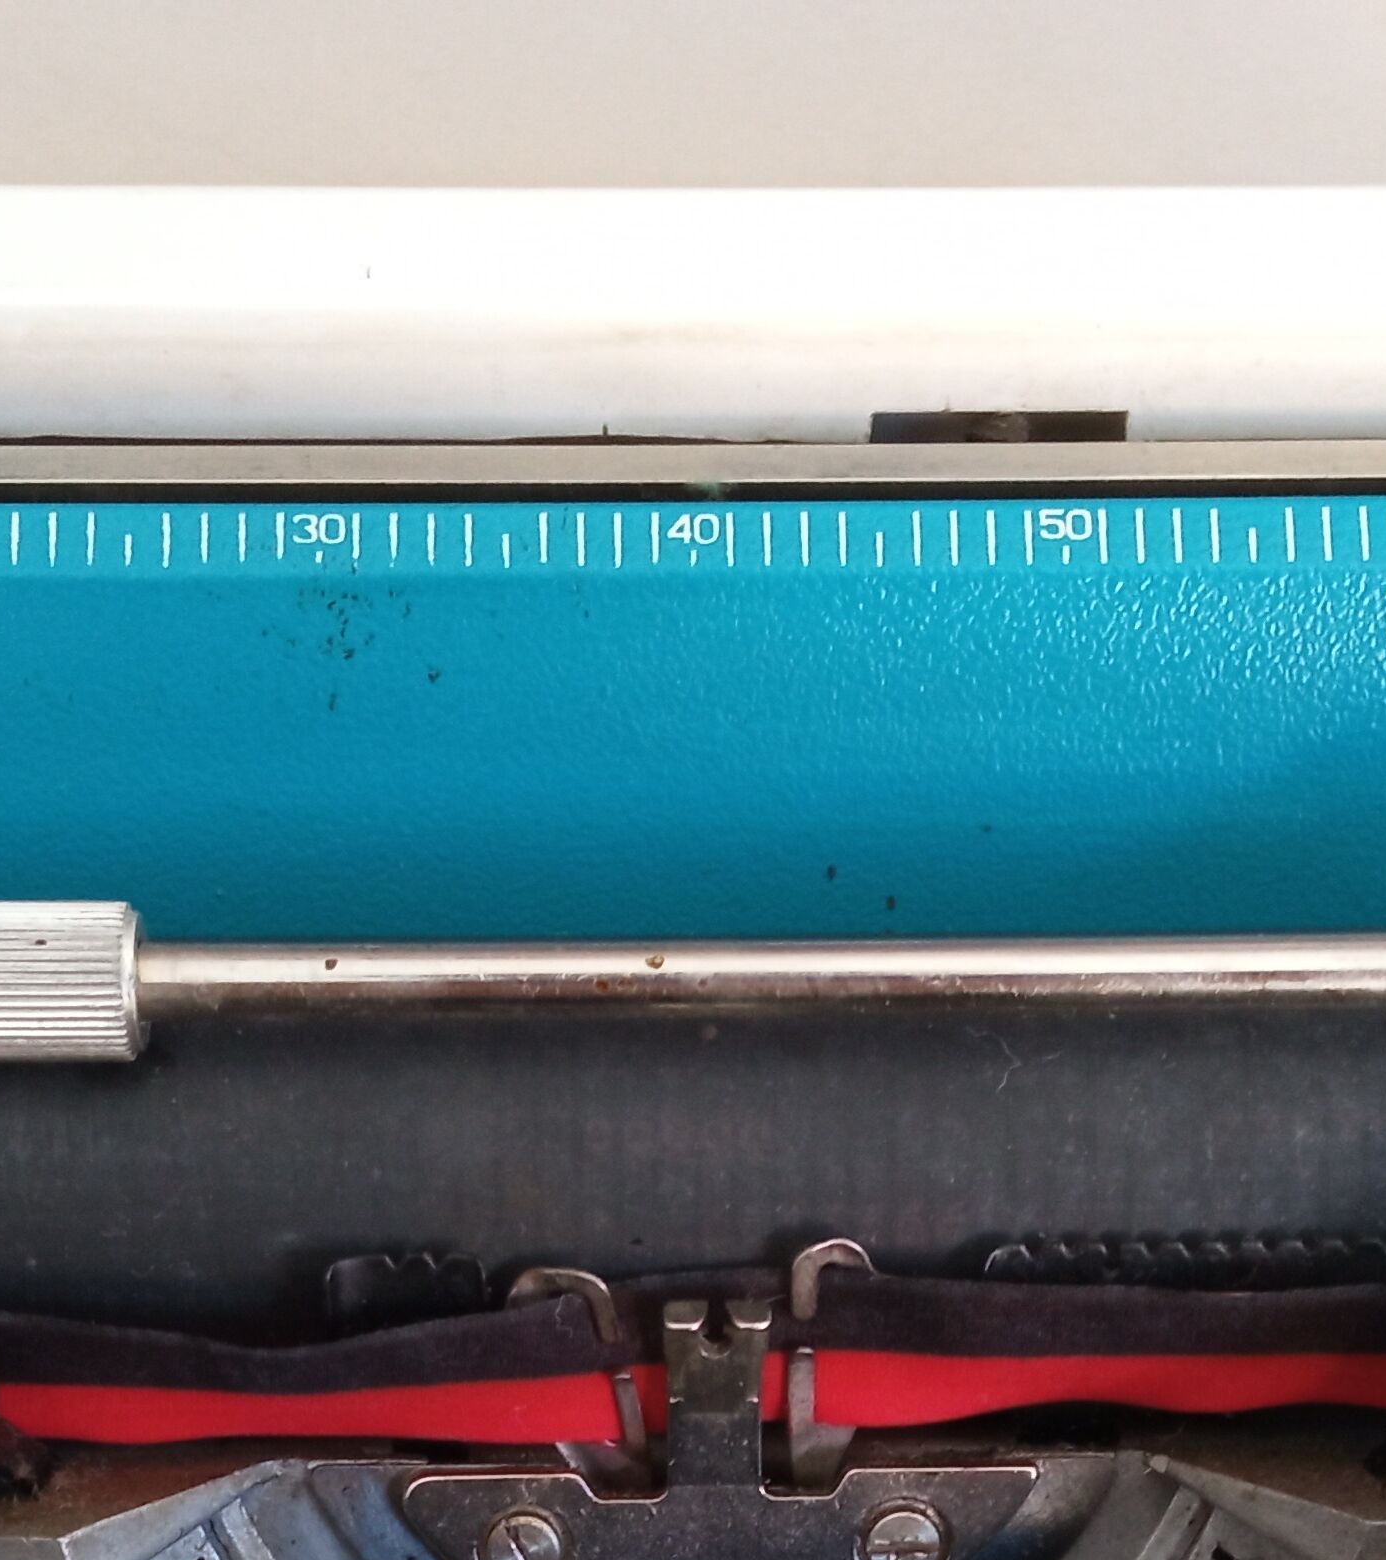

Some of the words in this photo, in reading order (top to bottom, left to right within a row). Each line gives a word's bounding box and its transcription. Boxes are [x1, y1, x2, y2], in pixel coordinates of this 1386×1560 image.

[291, 513, 346, 545] 30
[667, 512, 721, 546] 40
[1038, 507, 1094, 541] 50
